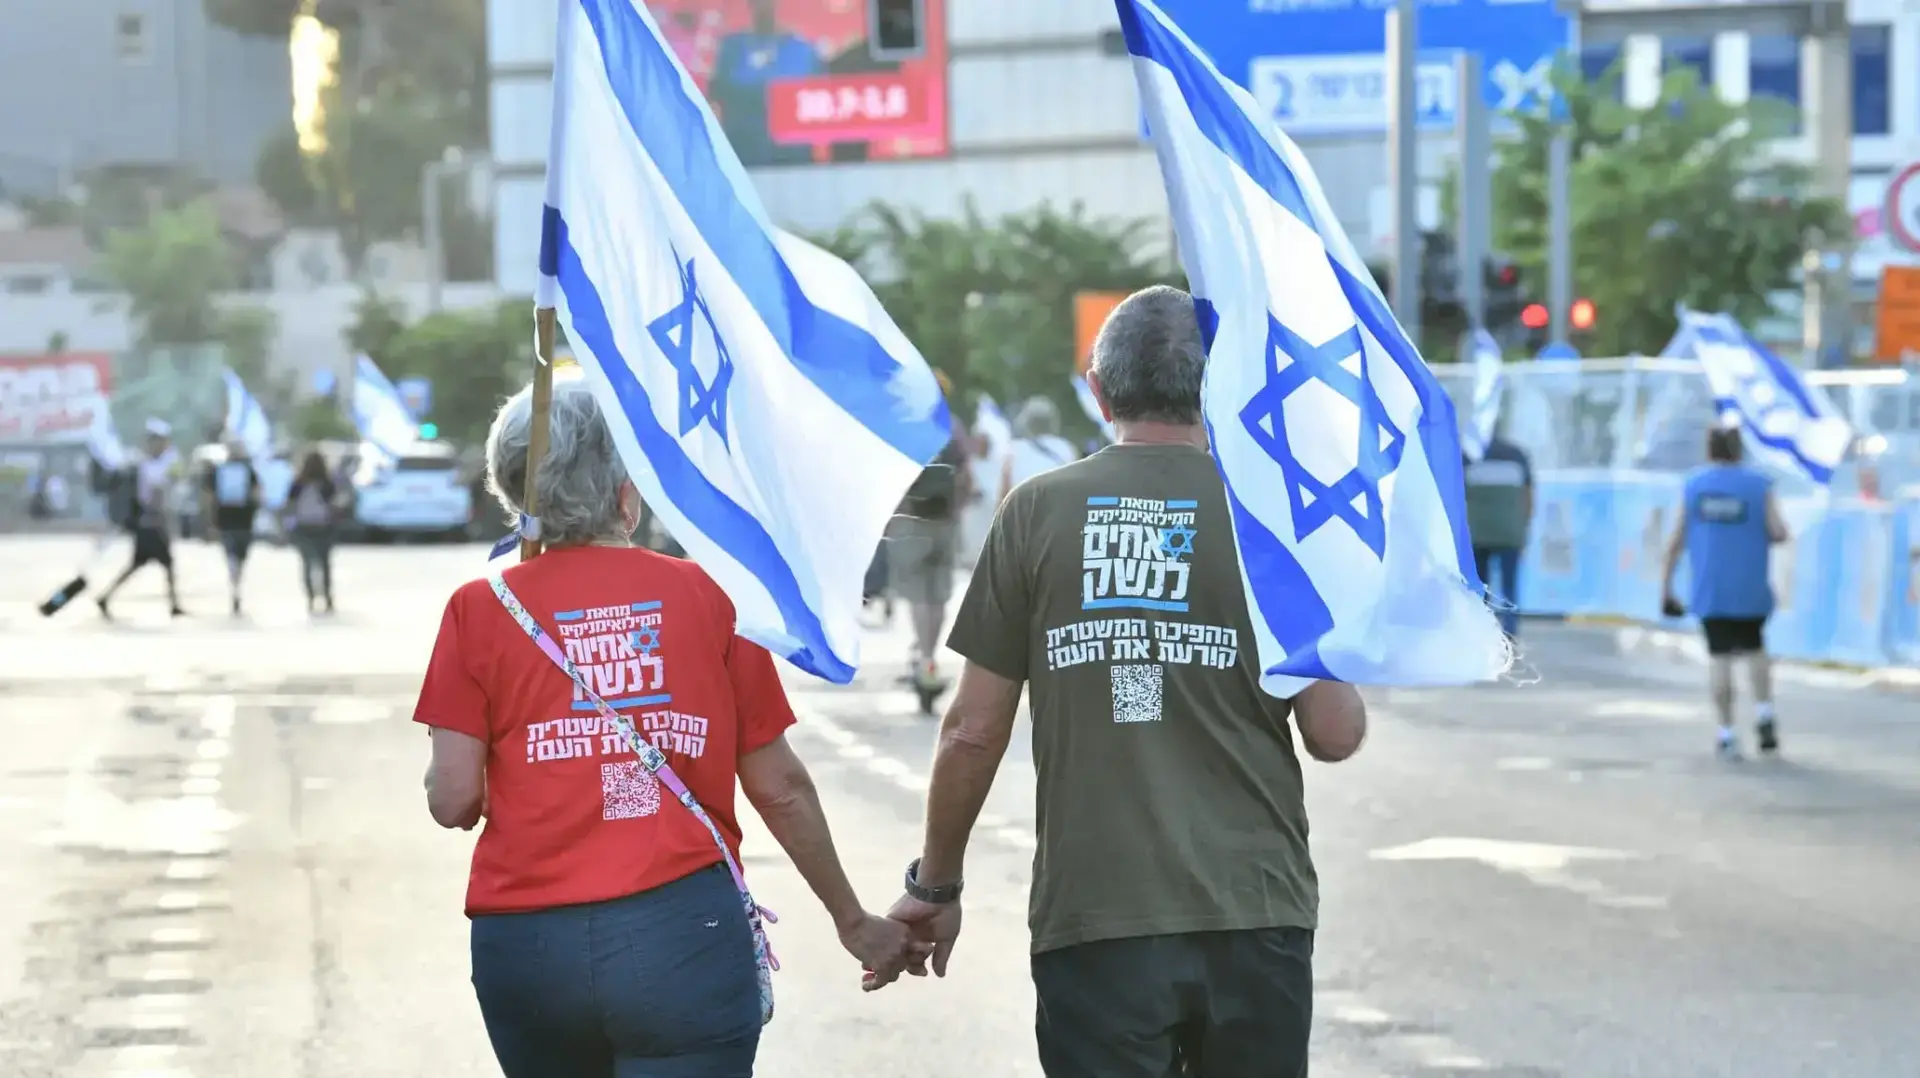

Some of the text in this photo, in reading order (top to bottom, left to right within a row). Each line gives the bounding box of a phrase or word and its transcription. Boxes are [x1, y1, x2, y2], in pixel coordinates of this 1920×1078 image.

[1087, 509, 1195, 526] המילואימניקים
[1118, 497, 1165, 512] מחאת
[1083, 523, 1166, 561] אחים
[1082, 557, 1191, 604] לנשק
[558, 612, 662, 638] המילואימניקים
[585, 604, 631, 620] מחאת
[1047, 618, 1237, 648] ההפיכה המשטרית
[564, 632, 638, 664] אחיות
[1047, 639, 1237, 671] קורעת את העם!
[641, 710, 708, 736] ההכה
[527, 736, 593, 763] העם!
[649, 730, 706, 759] קורת
